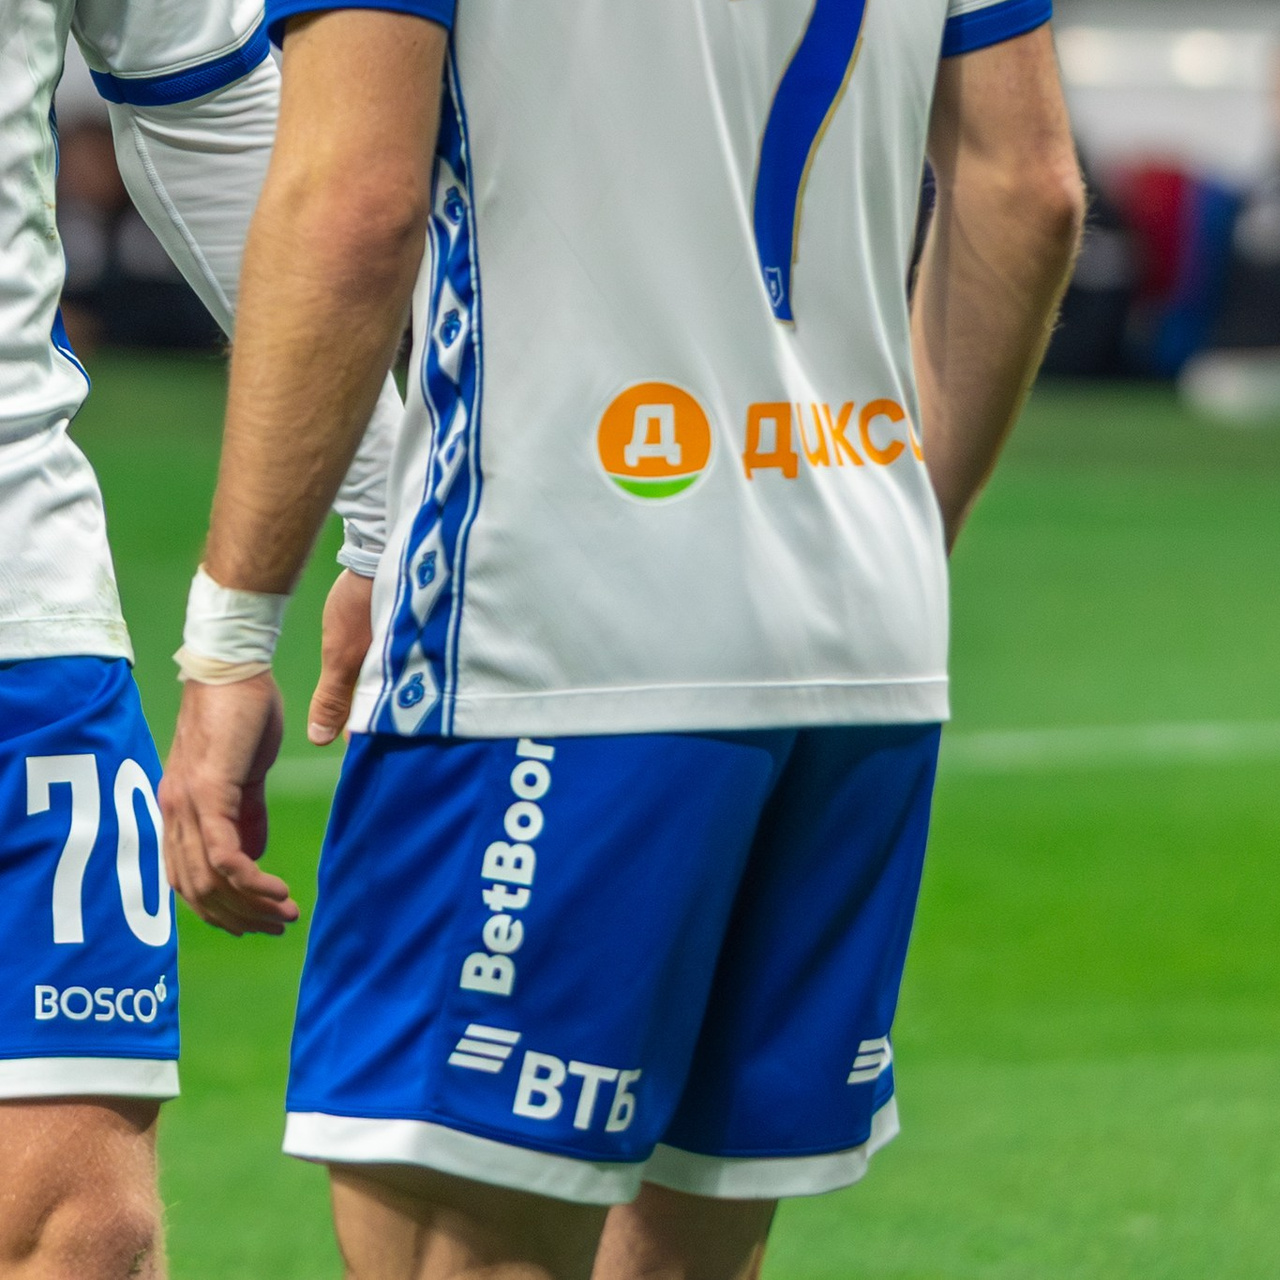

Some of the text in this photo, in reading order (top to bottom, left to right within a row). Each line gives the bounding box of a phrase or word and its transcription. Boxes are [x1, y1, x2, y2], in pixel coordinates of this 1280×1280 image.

[26, 753, 172, 948] 70
[35, 984, 158, 1024] BOSCO
[512, 1050, 643, 1133] ВТБ
